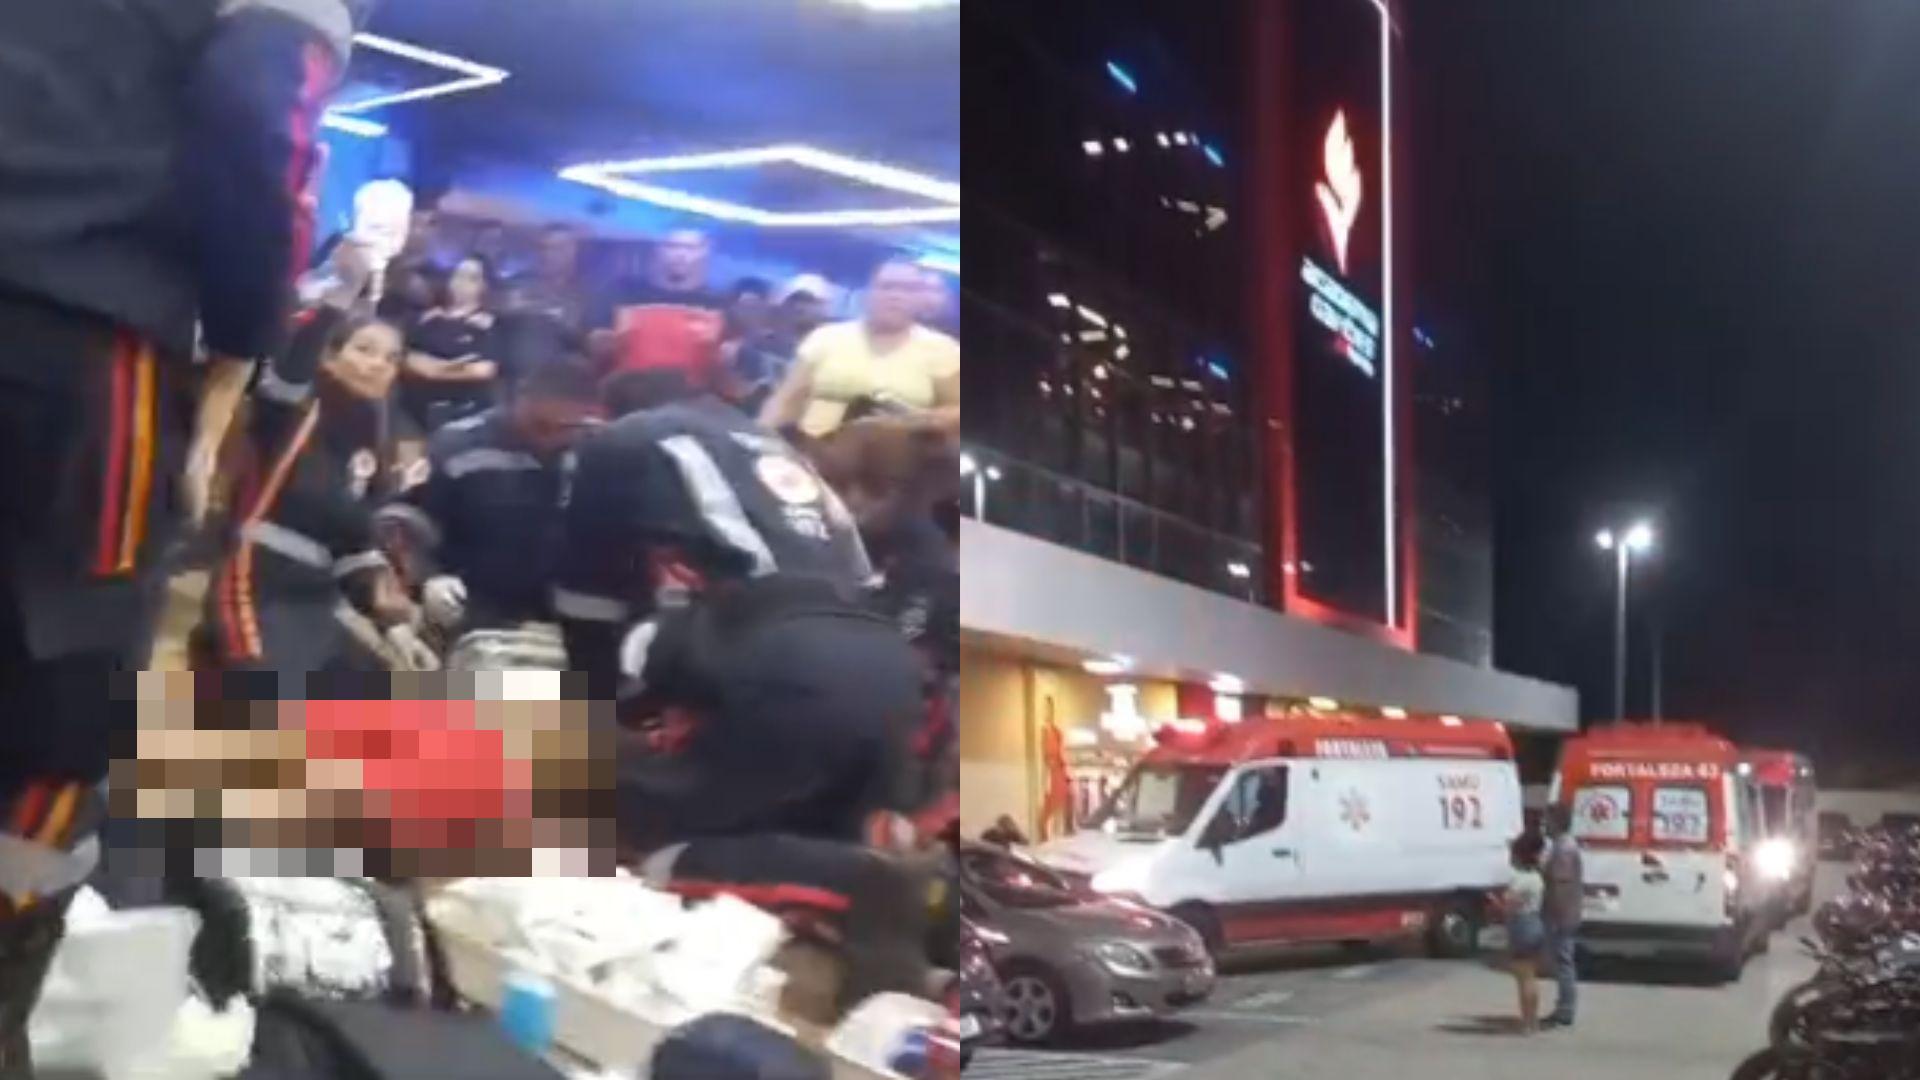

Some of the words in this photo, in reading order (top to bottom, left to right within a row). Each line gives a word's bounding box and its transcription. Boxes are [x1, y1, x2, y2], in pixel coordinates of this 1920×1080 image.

[1589, 762, 1692, 778] FORTALEZA
[1437, 773, 1480, 790] SAMU
[1439, 796, 1482, 829] 192
